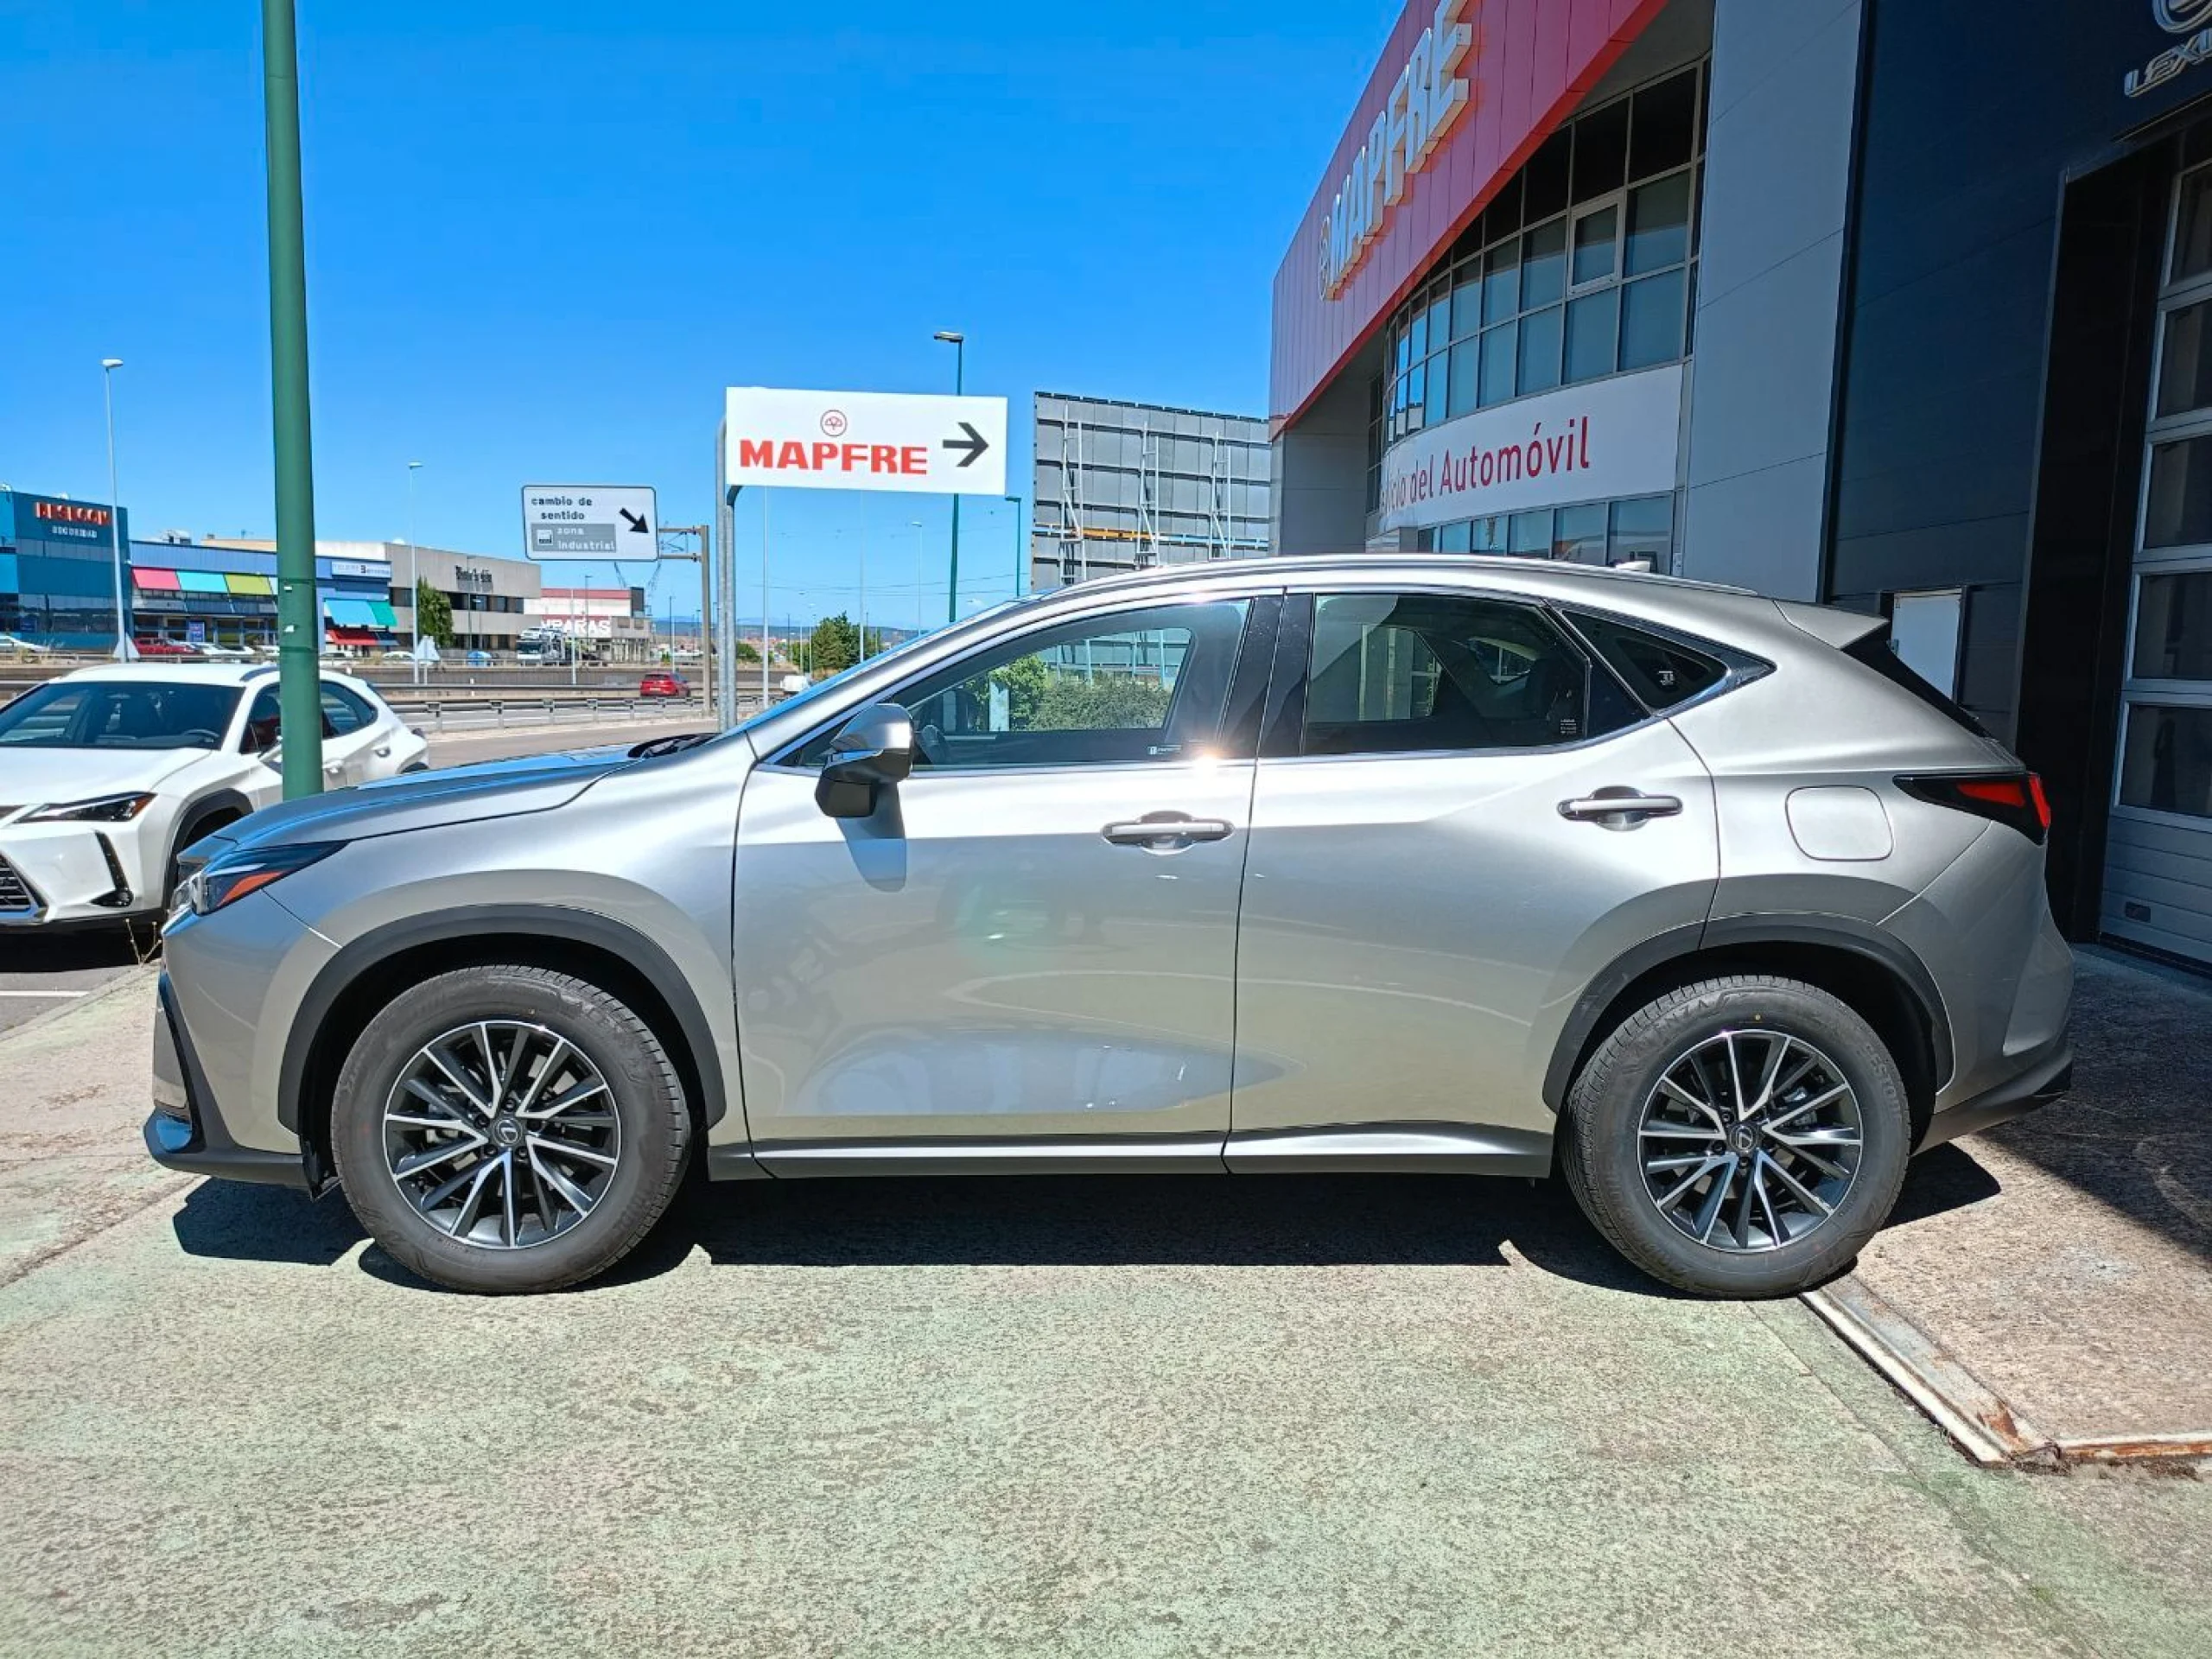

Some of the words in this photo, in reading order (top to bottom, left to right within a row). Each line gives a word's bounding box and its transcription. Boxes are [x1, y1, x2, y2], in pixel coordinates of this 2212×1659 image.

[1327, 0, 1471, 299] MAPFRE
[740, 438, 927, 474] MAPFRE
[1409, 454, 1434, 504] del
[1439, 416, 1590, 497] Automóvil
[531, 496, 573, 506] cambio
[578, 497, 593, 506] de
[541, 511, 585, 520] sentido
[556, 527, 585, 536] zona
[557, 540, 615, 550] industrial
